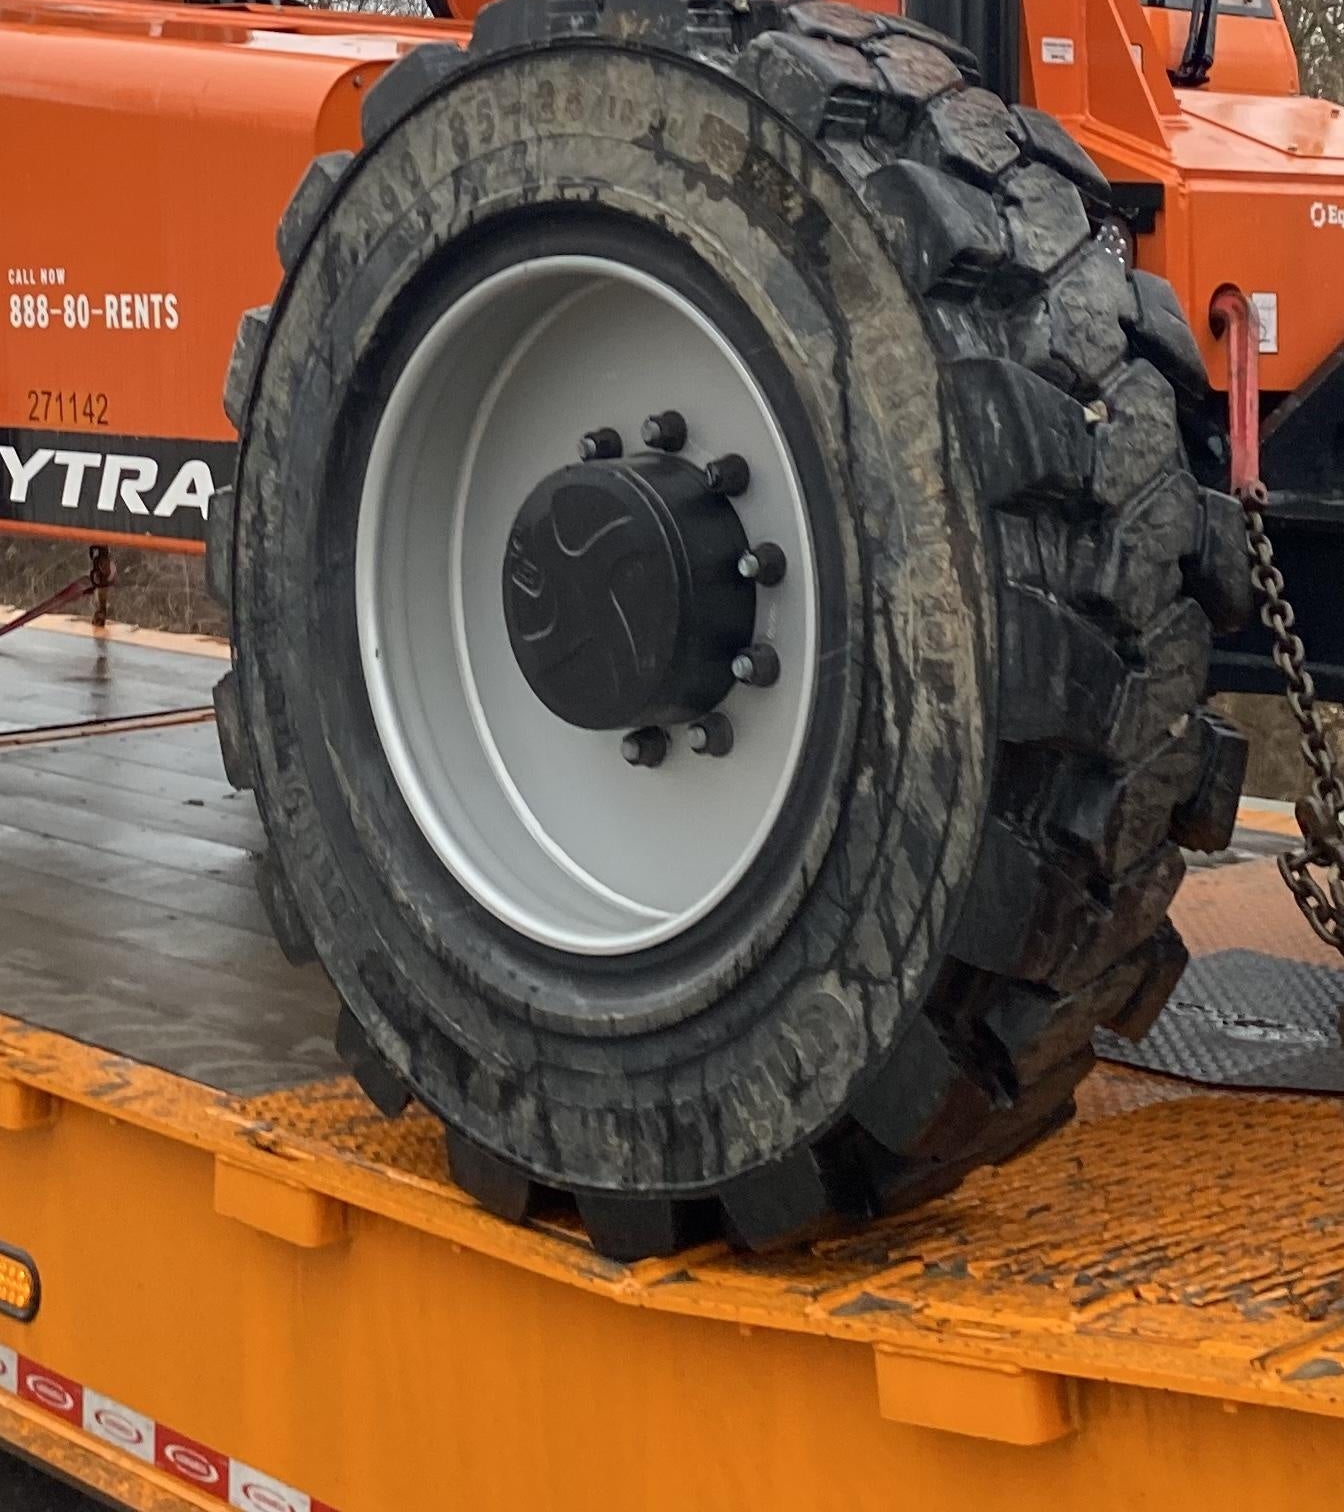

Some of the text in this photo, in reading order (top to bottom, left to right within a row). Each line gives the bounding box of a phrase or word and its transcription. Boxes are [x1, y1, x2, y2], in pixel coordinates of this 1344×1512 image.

[8, 267, 66, 286] CALL NOW
[9, 293, 180, 330] 888-80-RENTS
[27, 390, 110, 425] 271142
